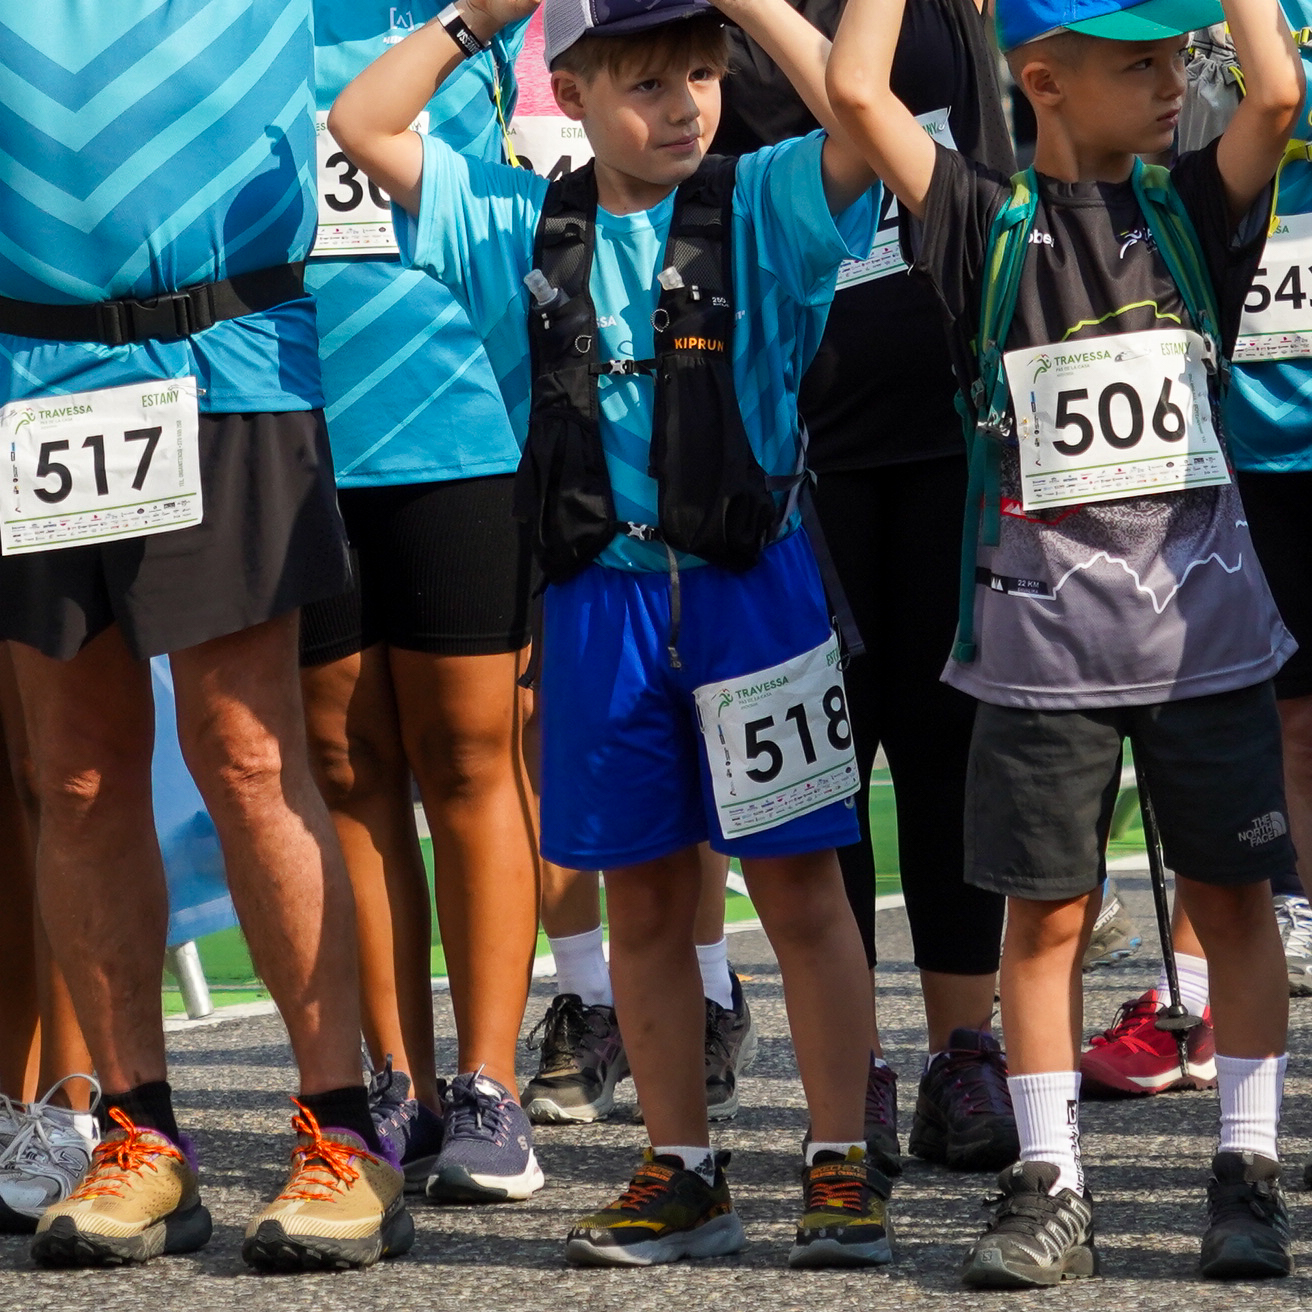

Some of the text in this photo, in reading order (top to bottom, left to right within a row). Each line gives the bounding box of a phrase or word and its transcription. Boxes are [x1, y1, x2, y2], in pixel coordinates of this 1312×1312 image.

[674, 336, 724, 352] KIPRUN
[1160, 341, 1192, 357] ESTANY
[1054, 349, 1112, 366] TRAVESSA
[142, 390, 180, 408] ESTANY
[39, 404, 94, 420] TRAVESSA
[1052, 376, 1186, 457] 506
[33, 426, 163, 504] 517
[735, 675, 789, 700] TRAVESSA
[744, 685, 853, 783] 518
[1251, 813, 1271, 829] THE
[1238, 822, 1272, 842] NORTH
[1250, 833, 1275, 848] FACE
